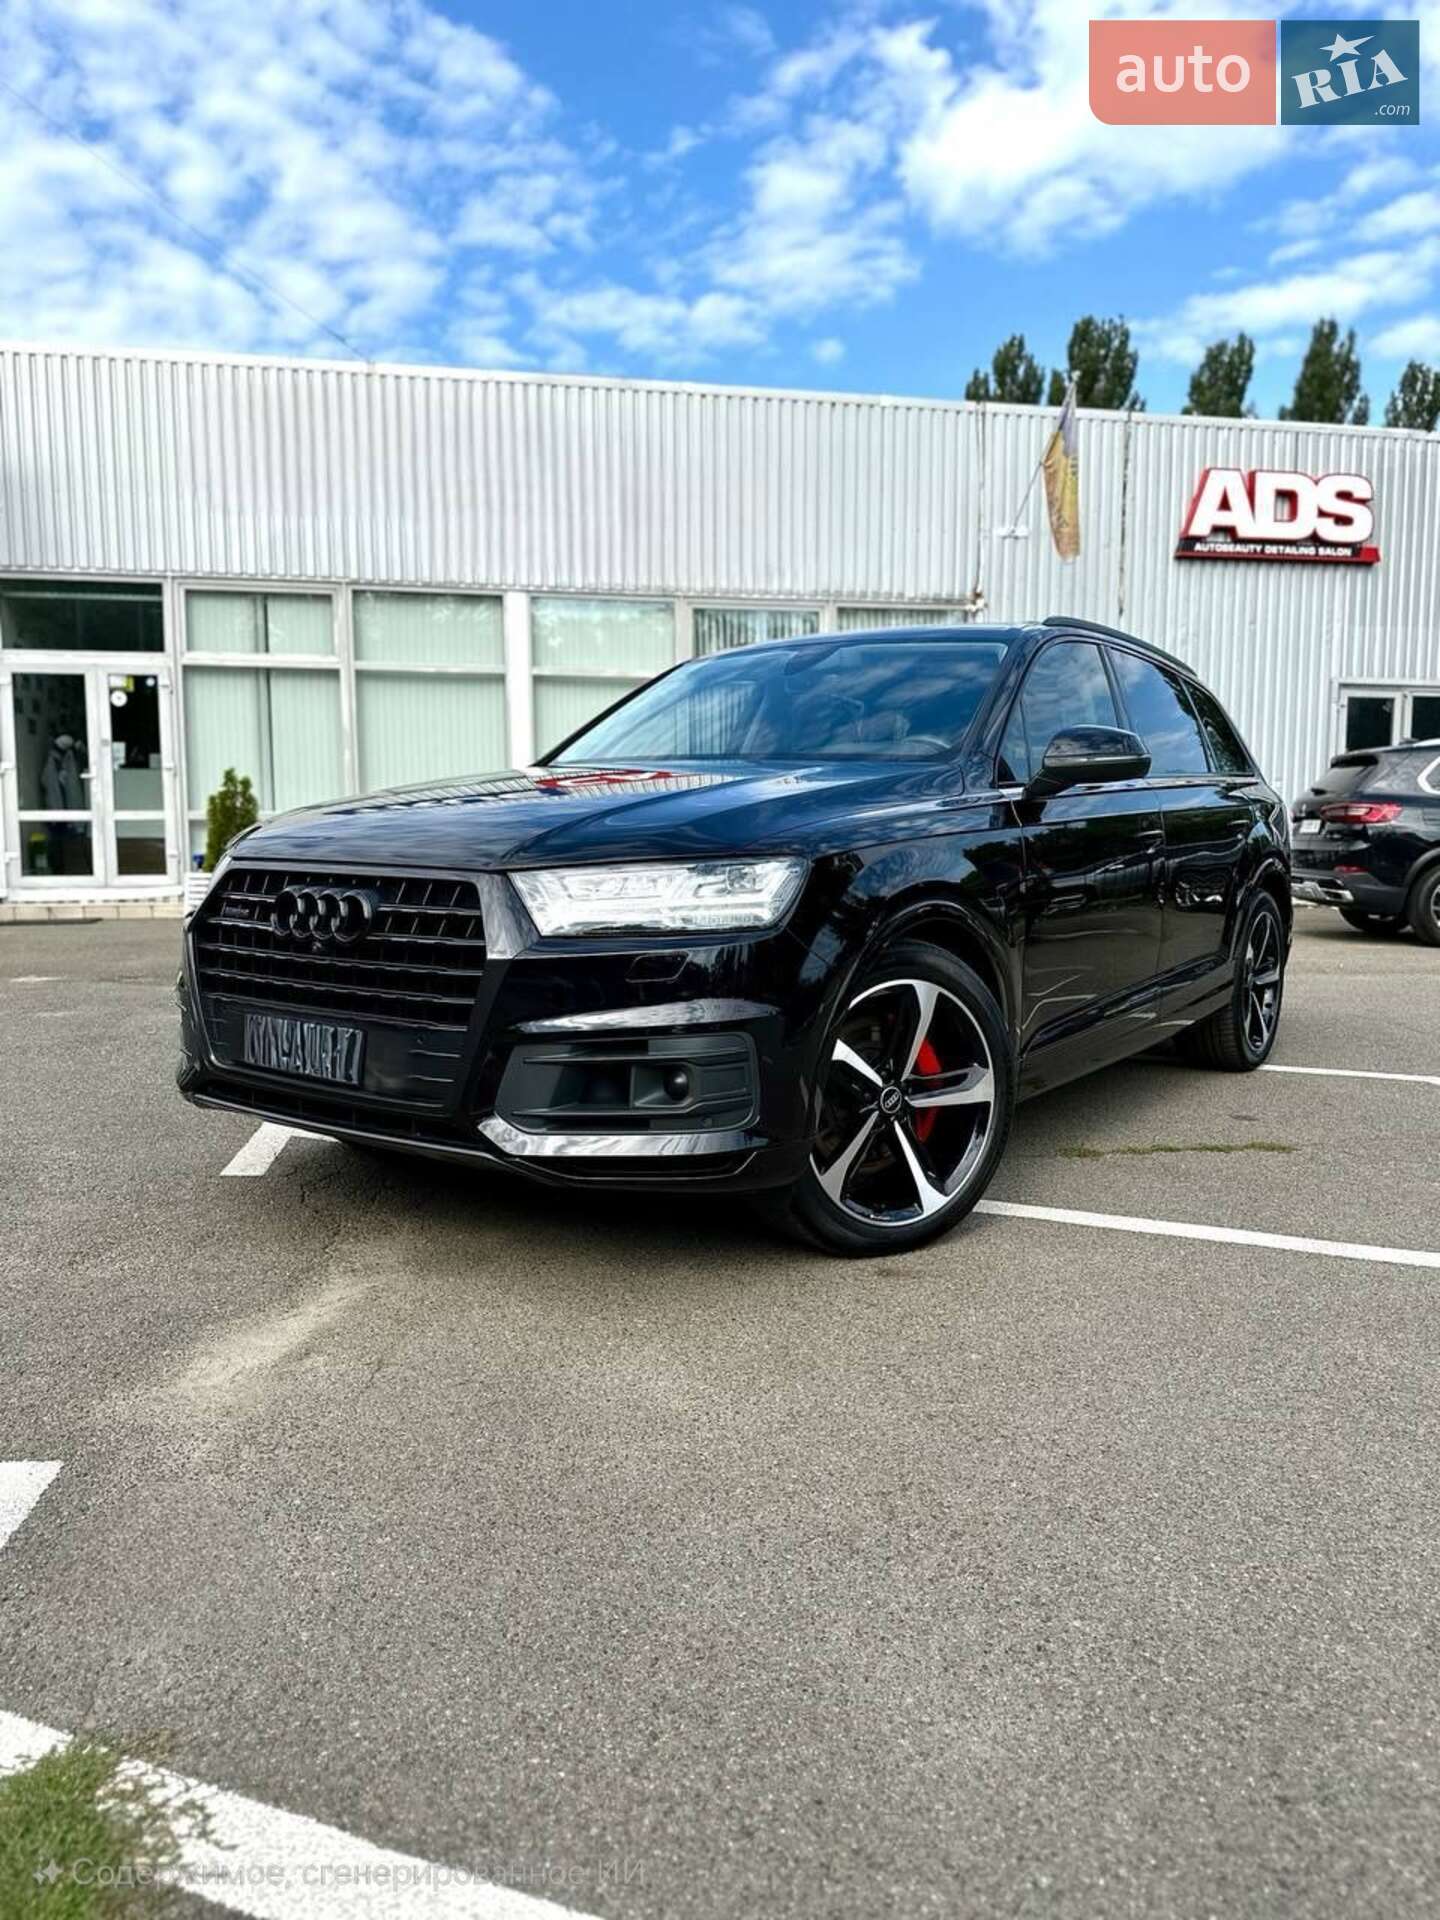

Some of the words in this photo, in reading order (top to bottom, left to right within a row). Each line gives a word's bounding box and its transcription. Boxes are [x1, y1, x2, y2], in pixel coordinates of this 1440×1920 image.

[1186, 468, 1374, 543] ADS
[1194, 542, 1263, 553] AUTOBEAUTY
[1264, 545, 1317, 556] DETAILING
[1318, 546, 1352, 557] SALON
